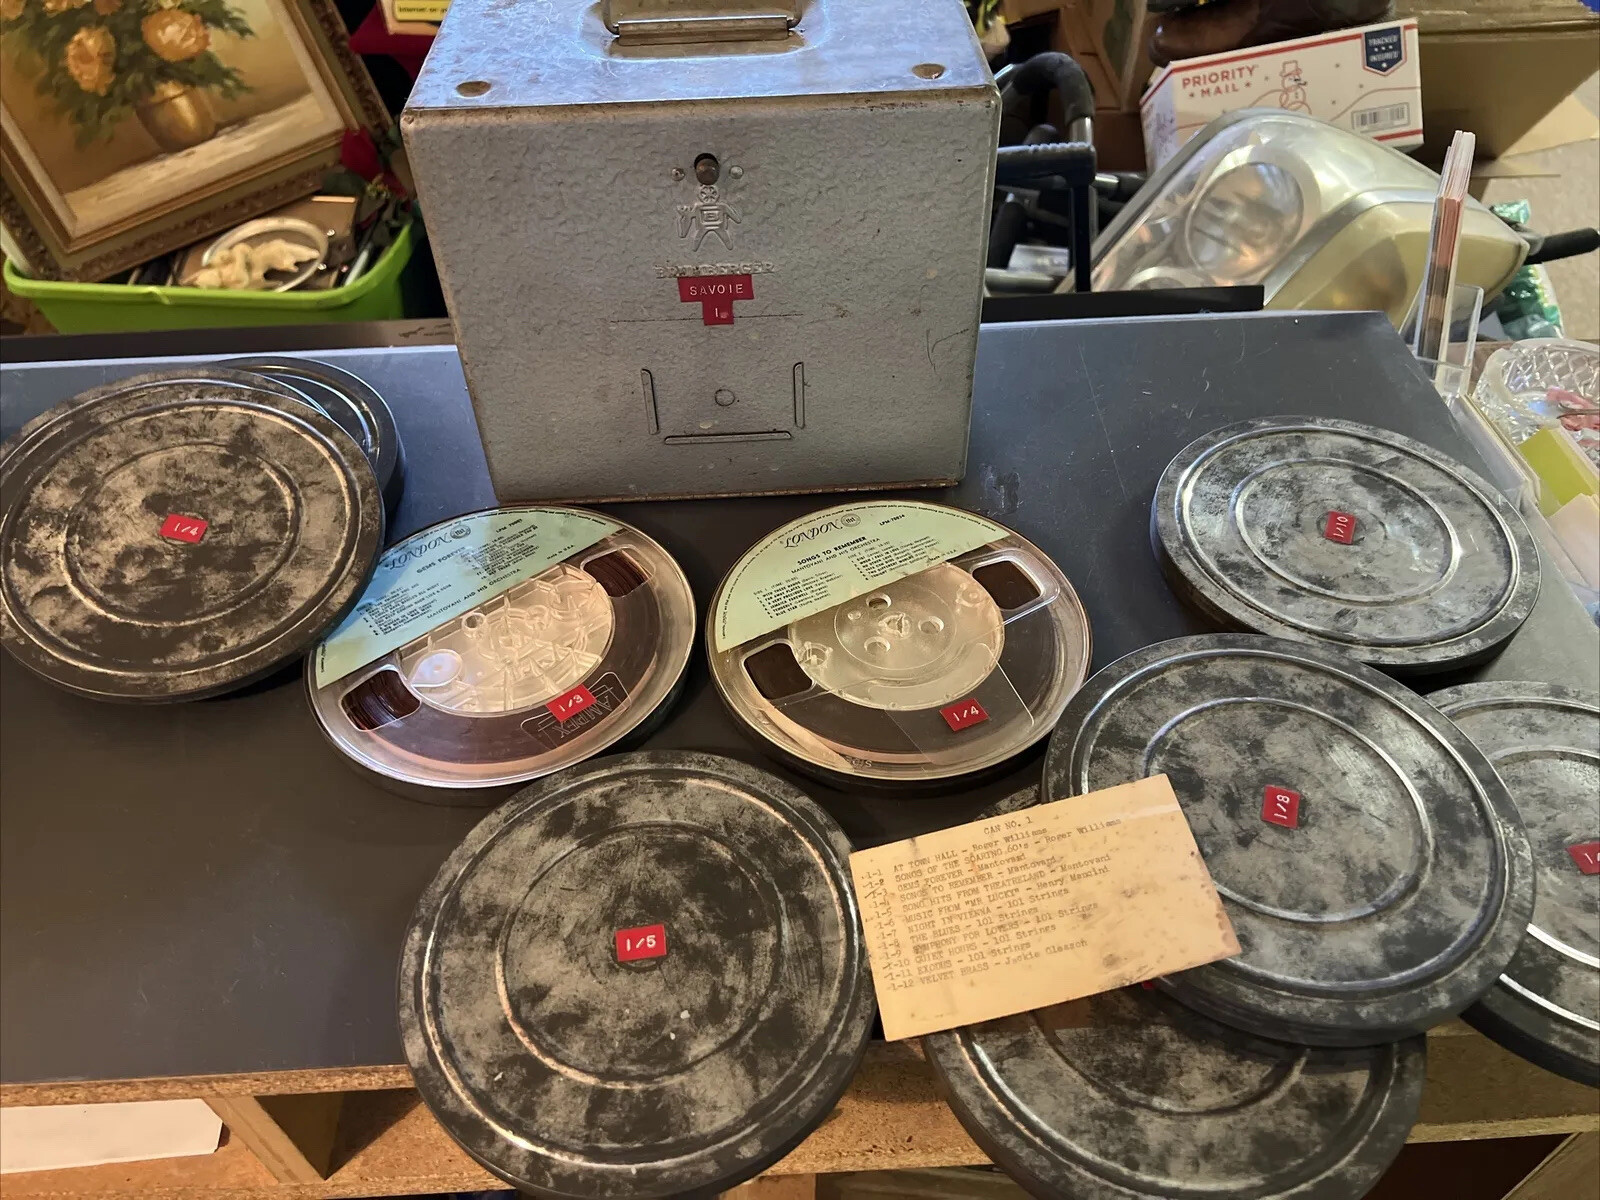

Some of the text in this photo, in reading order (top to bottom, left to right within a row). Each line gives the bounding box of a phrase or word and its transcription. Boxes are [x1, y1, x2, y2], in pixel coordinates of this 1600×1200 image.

[1182, 65, 1255, 89] PRIORITY
[1200, 83, 1239, 97] MAIL
[690, 284, 744, 296] SAVOIE
[174, 522, 199, 536] 1/4
[784, 519, 843, 548] LONDON
[1332, 516, 1349, 538] 1/10
[389, 533, 452, 570] LONDON
[416, 562, 436, 573] GEMS
[791, 559, 823, 574] MANTOVANI
[825, 553, 837, 561] AND
[850, 537, 880, 552] ORCHESTRA
[797, 553, 821, 565] SONGS
[833, 536, 867, 551] REMEMBER
[427, 568, 521, 619] MANTOVANI AND HIS ORCHESTRA
[953, 705, 979, 722] 1/4
[983, 815, 1033, 835] CAN NO. 1
[893, 863, 905, 872] AT
[910, 856, 931, 868] TOWN
[935, 849, 958, 862] HALL
[973, 838, 1000, 851] Roger
[1003, 825, 1048, 843] Williams
[895, 869, 923, 882] SONGS
[927, 865, 937, 874] OF
[943, 859, 959, 870] THE
[964, 848, 1003, 864] SOARING
[1045, 830, 1073, 843] Roger
[1077, 817, 1122, 834] Williams
[897, 879, 920, 892] GEMS
[925, 868, 964, 885] FOREVER
[978, 852, 1027, 871] Mantovani
[900, 888, 929, 901] SONGS
[933, 884, 944, 893] TO
[948, 872, 993, 889] REMEMBER
[1007, 856, 1057, 874] Mantovani
[902, 900, 924, 912] SONG
[930, 893, 952, 905] HITS
[957, 886, 980, 898] FROM
[984, 869, 1046, 892] THEATRELAND
[1060, 853, 1111, 872] Mantovani
[905, 909, 934, 923] MUSIC
[938, 902, 961, 915] FROM
[1037, 876, 1065, 891] Henry
[1069, 864, 1110, 881] Mancini
[908, 919, 936, 933] NIGHT
[942, 915, 954, 925] IN
[958, 905, 992, 920] VIENNA
[1006, 897, 1024, 908] 101
[1028, 886, 1070, 903] Strings
[910, 932, 928, 943] THE
[932, 924, 961, 938] BLUES
[976, 915, 993, 927] 101
[998, 904, 1039, 922] Strings
[963, 930, 980, 942] FOR
[985, 920, 1020, 936] LOVERS
[1036, 912, 1053, 923] 101
[1058, 900, 1099, 918] Strings
[626, 934, 656, 952] 1/5
[914, 950, 944, 965] QUIET
[948, 942, 977, 956] HOURS
[993, 933, 1011, 945] 101
[1015, 922, 1057, 940] Strings
[920, 969, 955, 986] VELVET
[960, 961, 989, 976] BRASS
[1004, 949, 1041, 966] Jackie
[1046, 937, 1088, 955] Gleason
[968, 951, 985, 963] 101
[990, 939, 1032, 958] Strings
